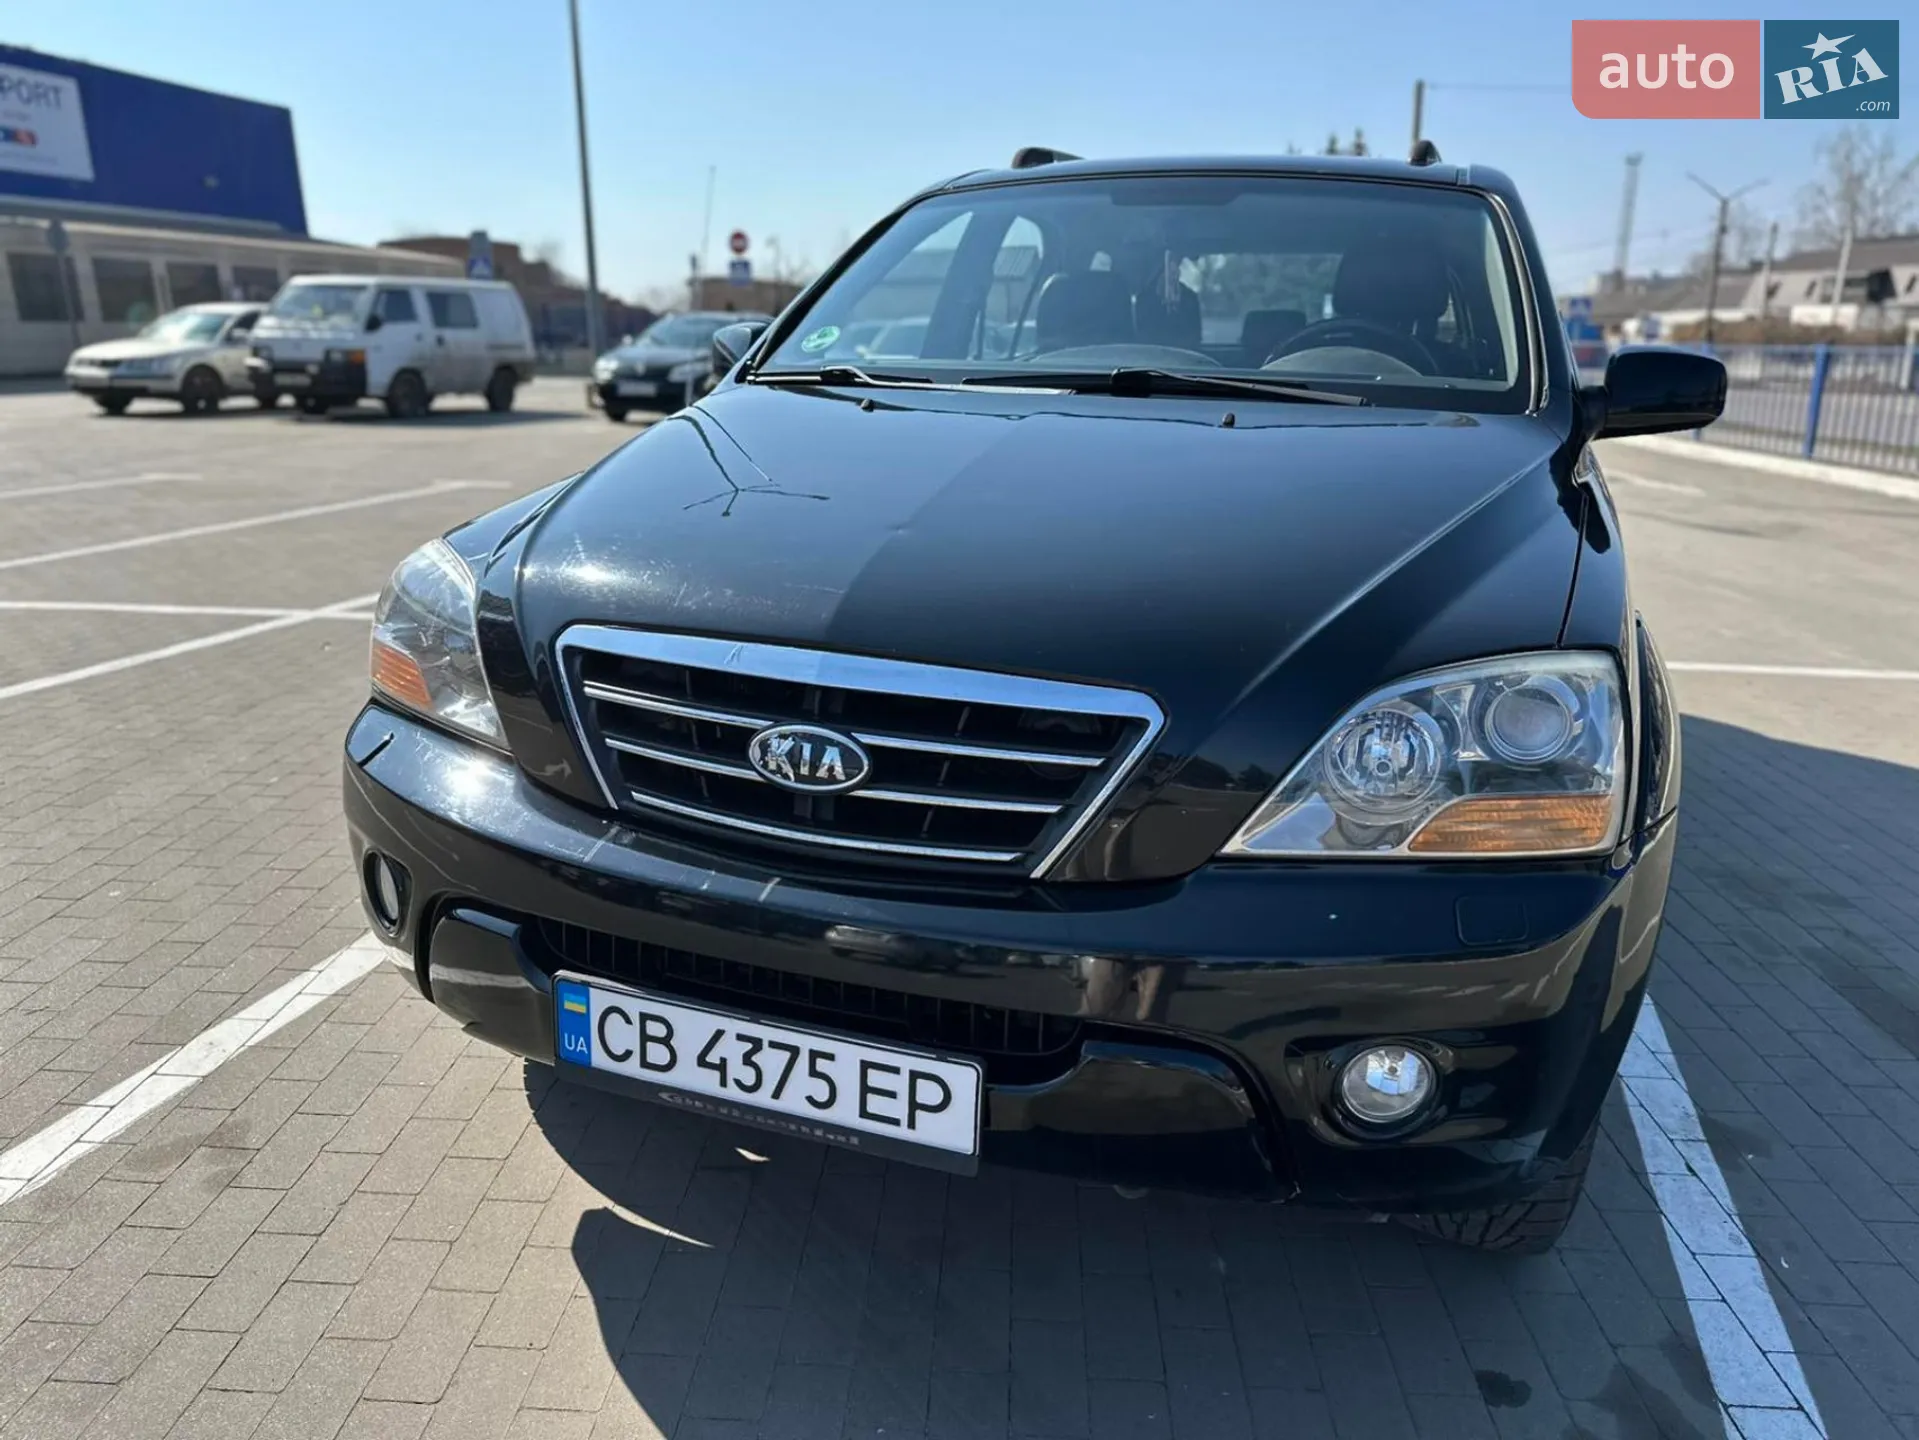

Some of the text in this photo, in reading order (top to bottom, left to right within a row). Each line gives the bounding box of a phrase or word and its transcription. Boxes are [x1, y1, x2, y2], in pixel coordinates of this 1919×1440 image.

[766, 734, 846, 782] KIA
[564, 1032, 588, 1055] UA
[597, 1005, 677, 1073] CB
[697, 1028, 837, 1110] 4375
[859, 1059, 952, 1130] EP
